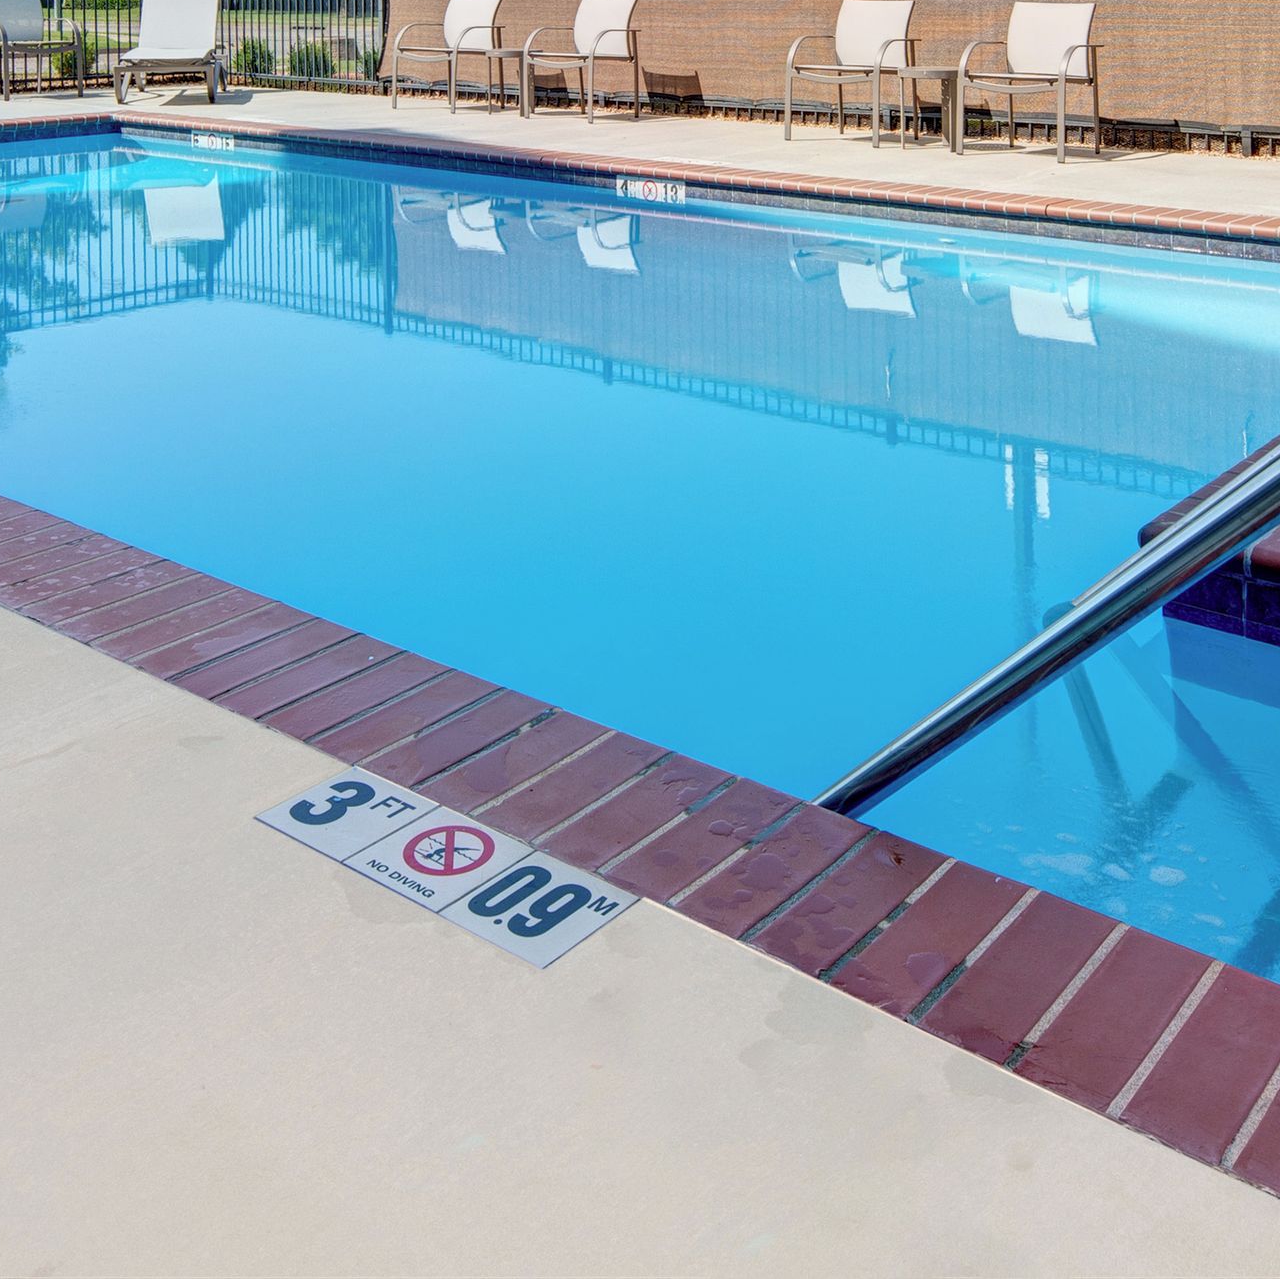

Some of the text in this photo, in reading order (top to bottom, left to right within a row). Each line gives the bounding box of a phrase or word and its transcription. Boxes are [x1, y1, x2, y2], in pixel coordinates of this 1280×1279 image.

[289, 781, 417, 826] 3 FT
[366, 858, 435, 899] NO DIVING
[586, 895, 620, 917] M
